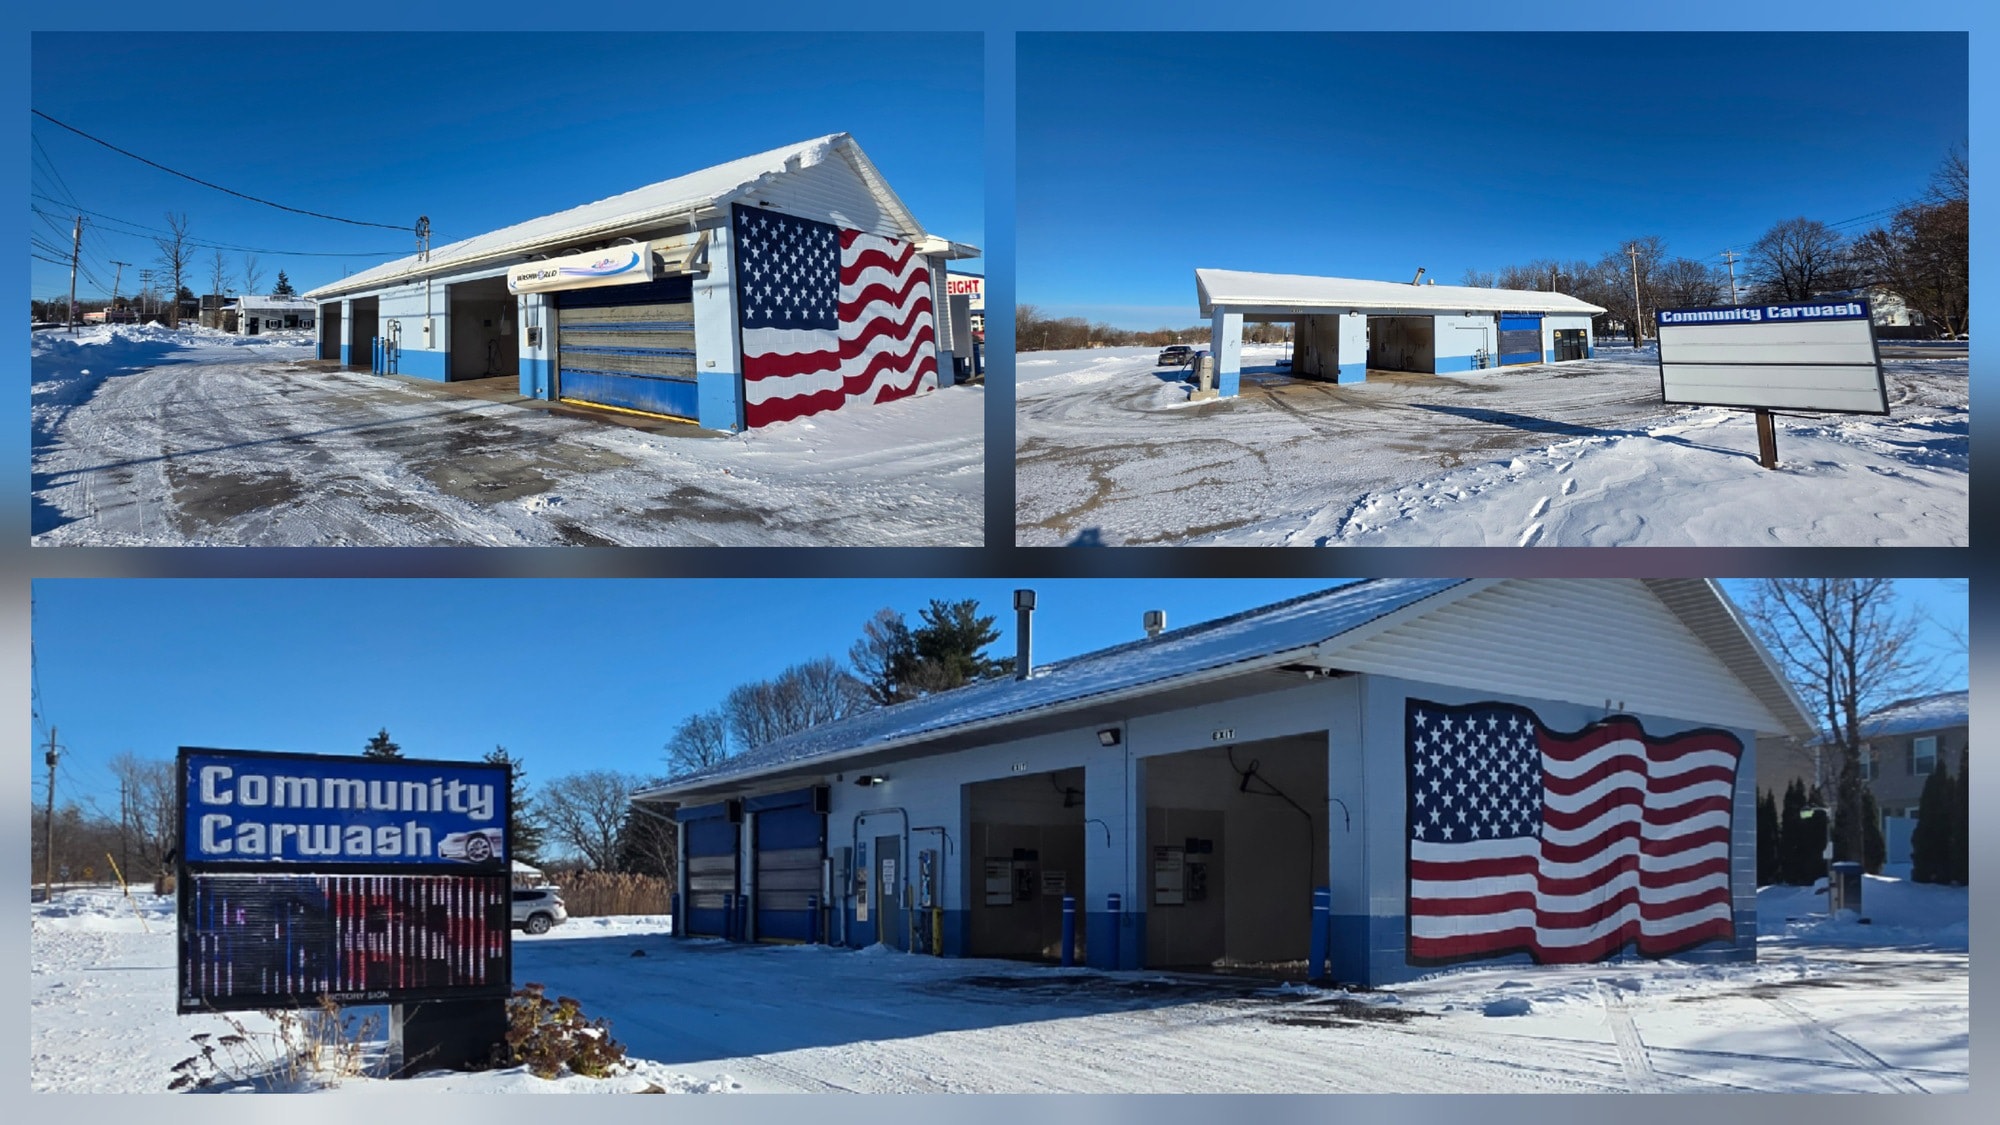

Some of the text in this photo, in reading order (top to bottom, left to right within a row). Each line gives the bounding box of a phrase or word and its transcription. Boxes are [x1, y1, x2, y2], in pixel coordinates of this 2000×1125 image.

[1661, 302, 1862, 323] Community Carwash
[1212, 729, 1235, 740] EXIT
[200, 765, 494, 820] Community
[200, 814, 432, 857] Carwash
[367, 990, 390, 1000] SIGN
